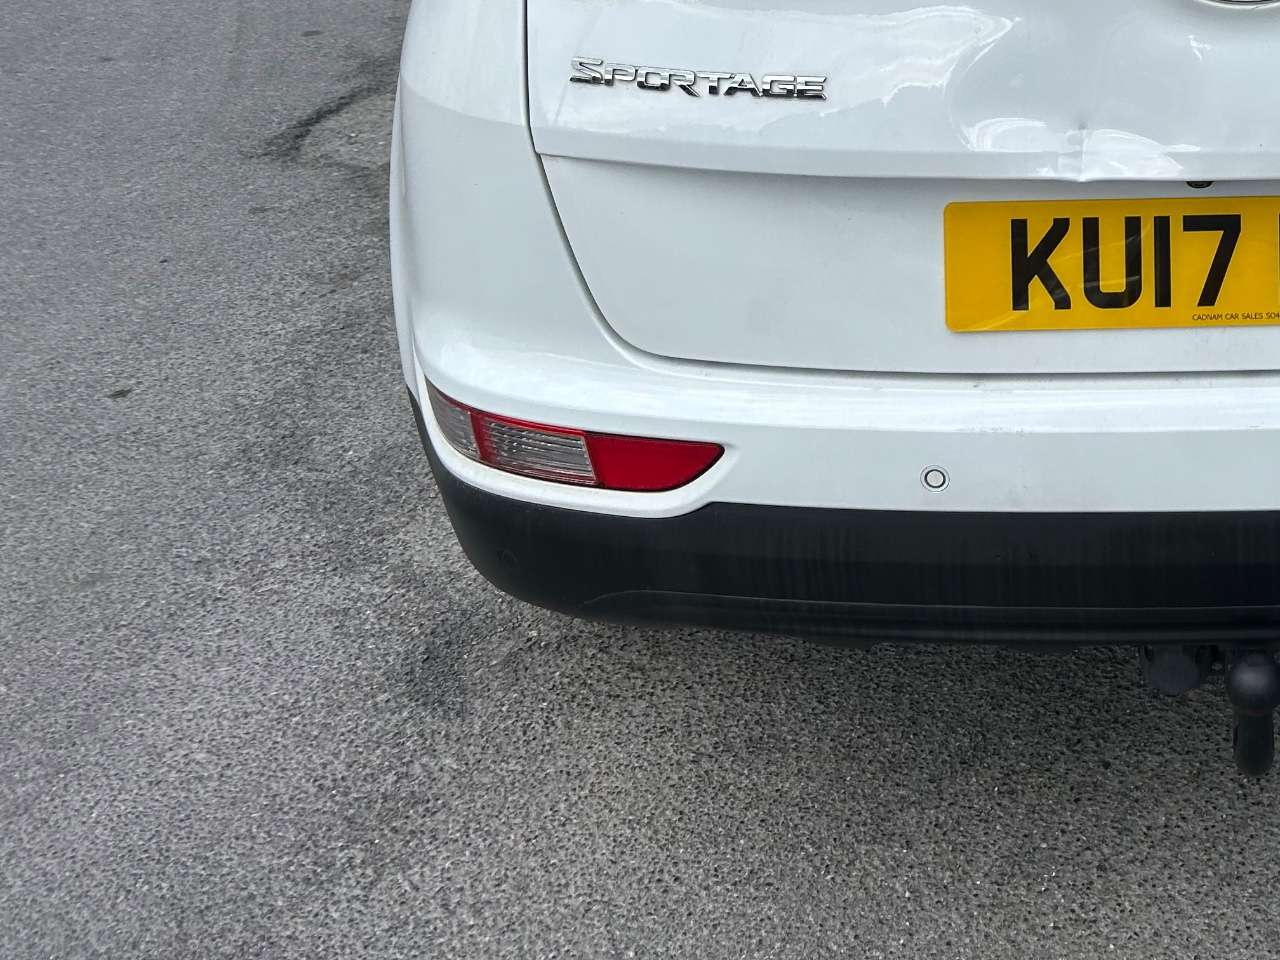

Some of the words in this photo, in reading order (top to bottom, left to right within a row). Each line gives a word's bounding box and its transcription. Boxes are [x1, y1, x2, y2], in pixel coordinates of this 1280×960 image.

[570, 56, 828, 100] SPORTAGE
[1010, 214, 1242, 311] KU17
[1192, 313, 1223, 321] CADNAM
[1225, 312, 1239, 320] CAR
[1241, 312, 1264, 320] SALES
